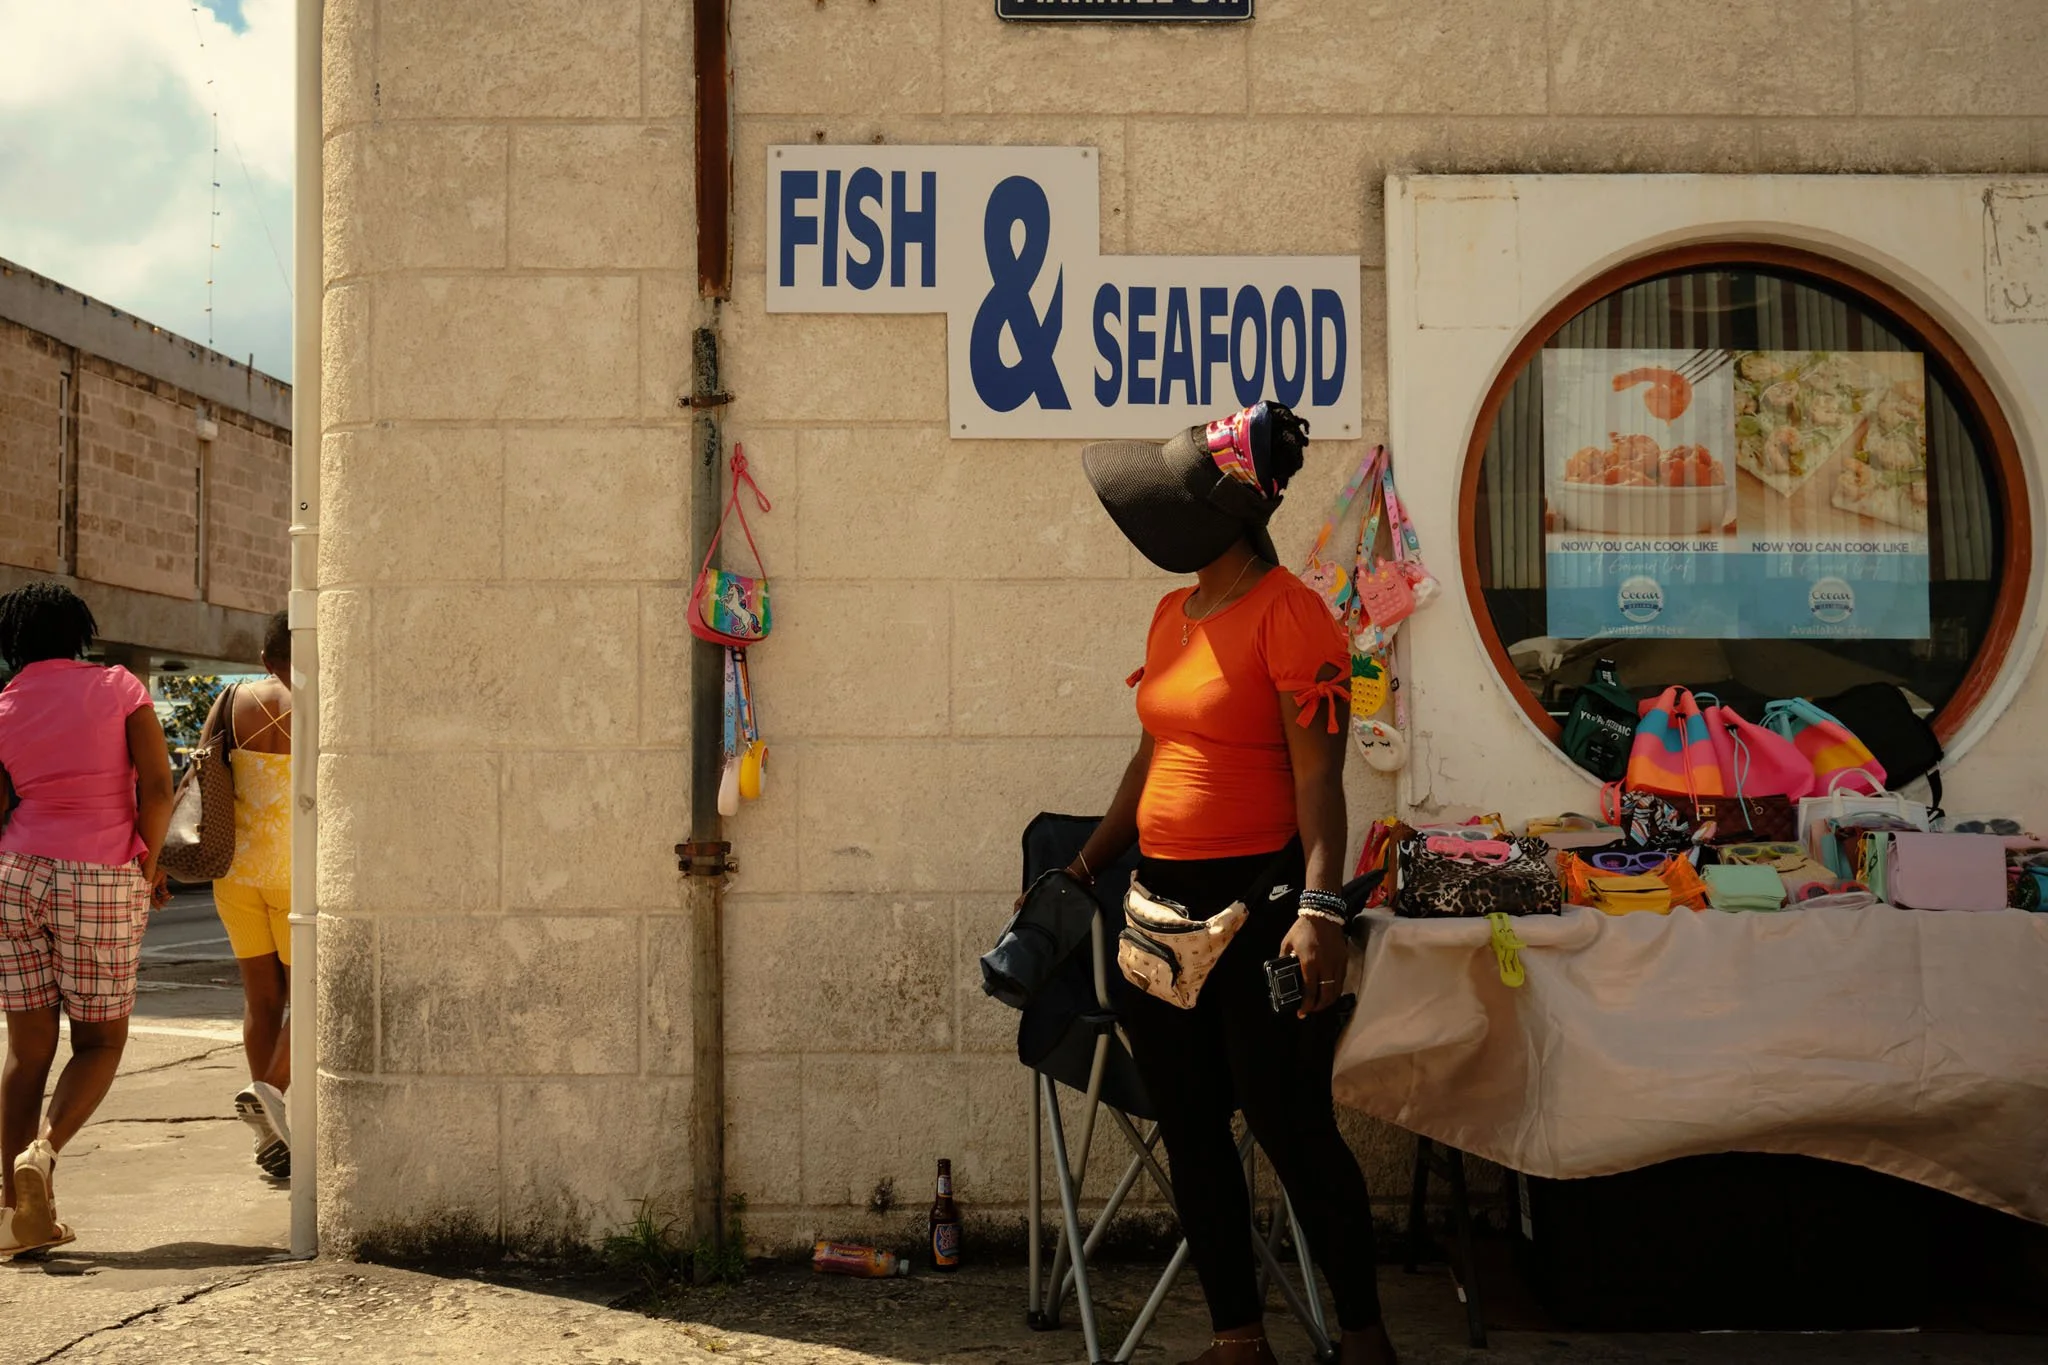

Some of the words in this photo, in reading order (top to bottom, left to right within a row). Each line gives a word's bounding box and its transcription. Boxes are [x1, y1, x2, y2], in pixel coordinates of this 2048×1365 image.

[779, 166, 938, 291] FISH
[969, 174, 1073, 413] &
[1092, 282, 1348, 408] SEAFOOD
[1560, 541, 1594, 552] NOW
[1596, 541, 1622, 552] YOU
[1624, 541, 1651, 552] CAN
[1653, 541, 1690, 552] COOK
[1692, 541, 1719, 552] LIKE
[1751, 542, 1784, 553] NOW
[1786, 542, 1813, 553] YOU
[1815, 542, 1842, 553] CAN
[1844, 542, 1881, 553] COOK
[1883, 542, 1910, 553] LIKE
[1790, 625, 1845, 636] Available
[1272, 884, 1289, 894] NIKE
